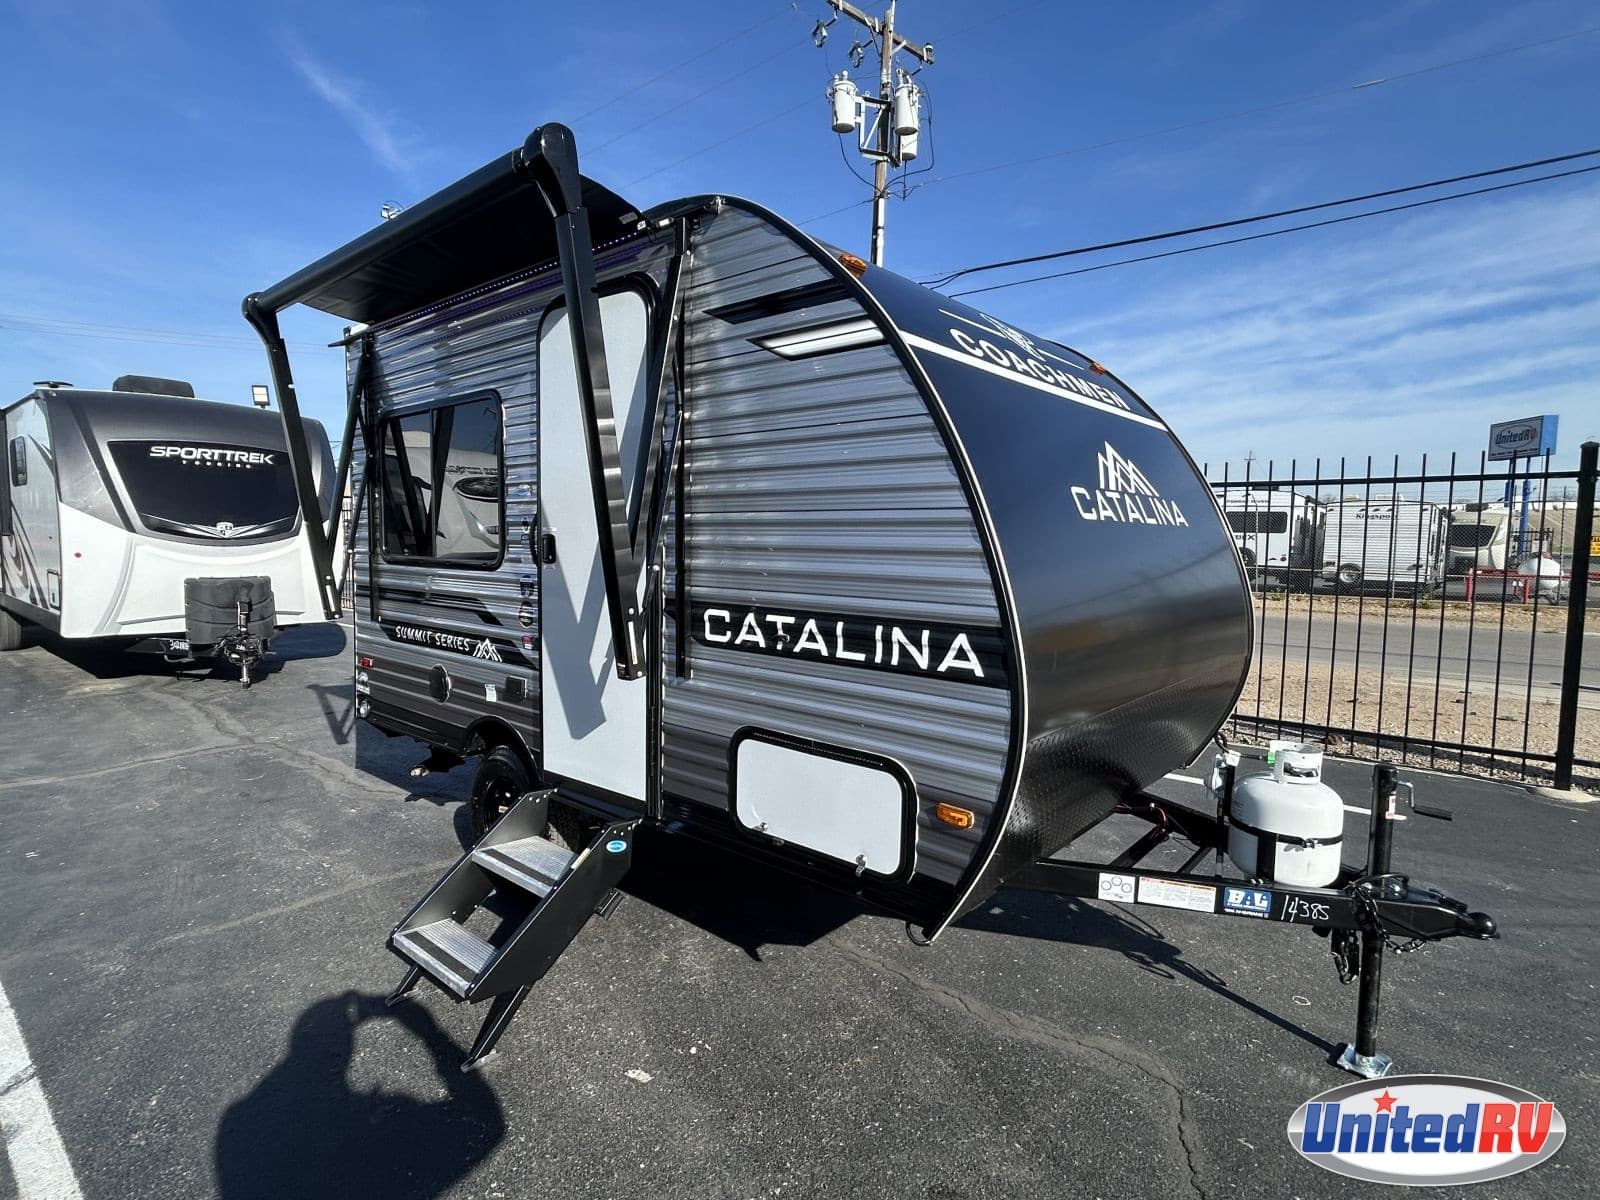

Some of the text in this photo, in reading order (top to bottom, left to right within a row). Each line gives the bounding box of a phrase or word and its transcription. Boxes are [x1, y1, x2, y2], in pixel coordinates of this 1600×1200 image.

[950, 328, 1131, 410] COACHMEN
[1495, 428, 1537, 445] UnitedRV
[150, 446, 275, 465] SPORTTREK
[1070, 486, 1189, 527] CATALINA
[395, 626, 470, 651] SUMMIT SERIES
[703, 608, 985, 678] CATALINA
[1281, 894, 1329, 923] 14385
